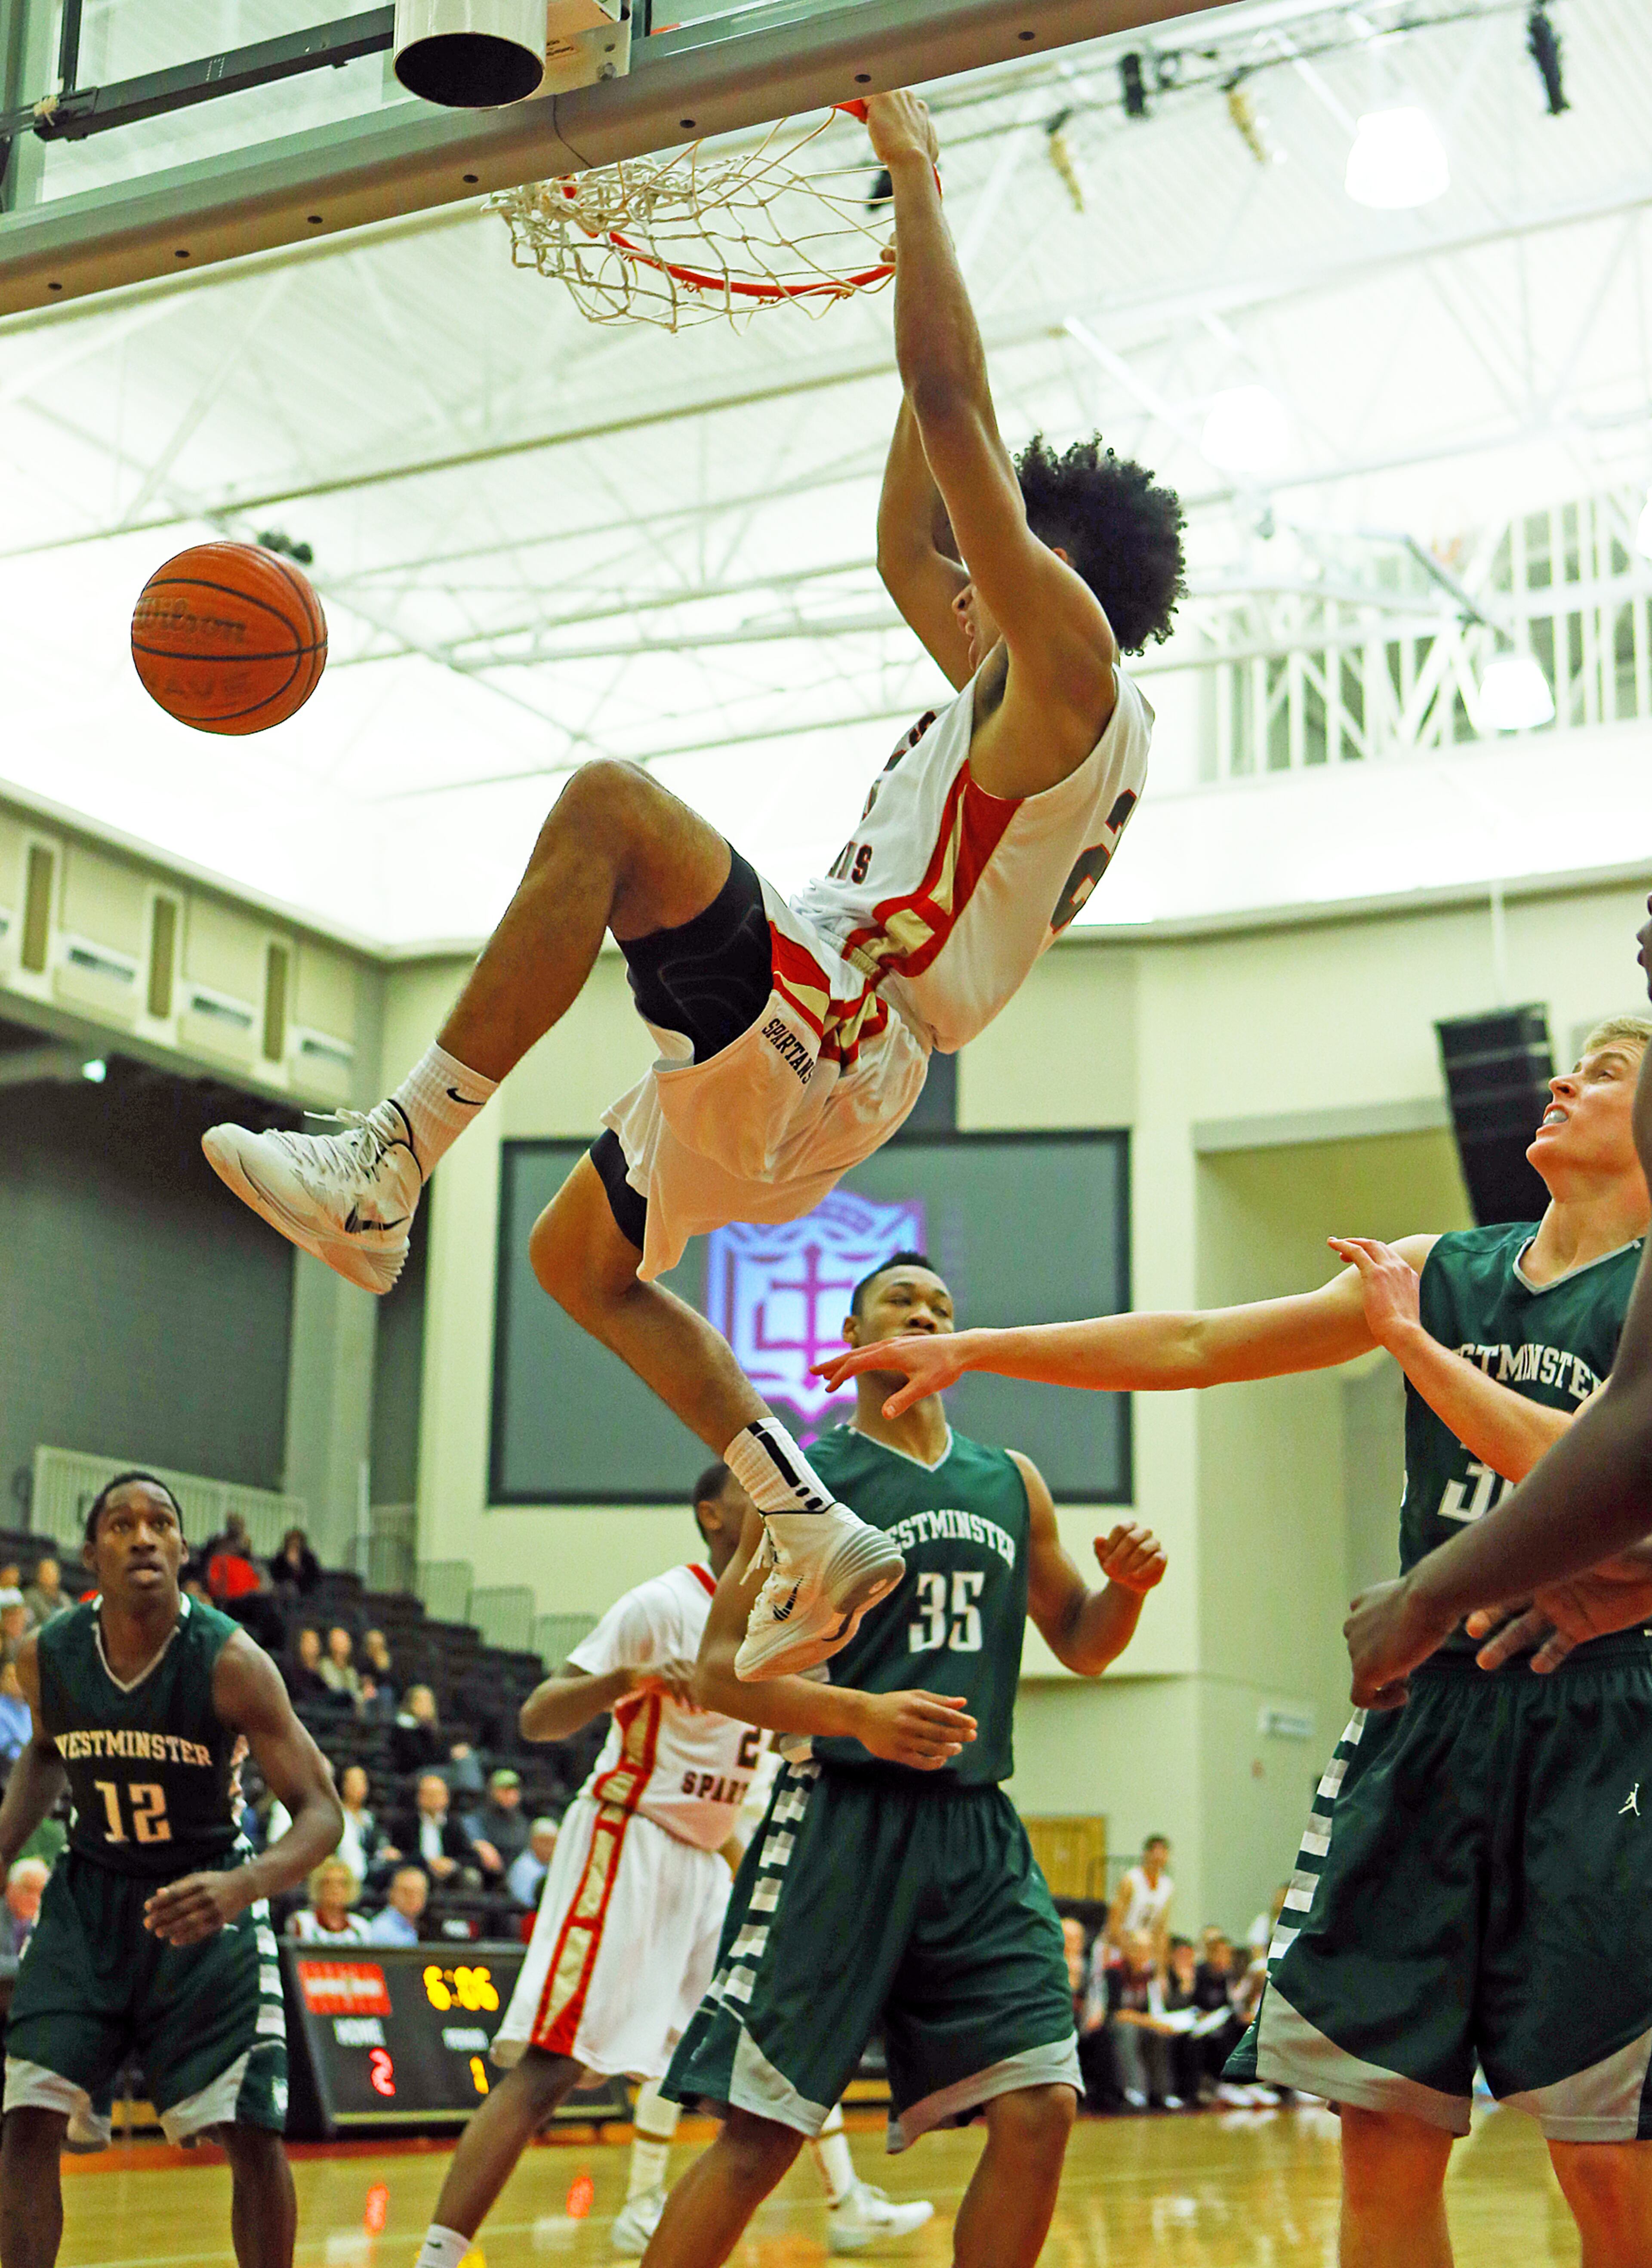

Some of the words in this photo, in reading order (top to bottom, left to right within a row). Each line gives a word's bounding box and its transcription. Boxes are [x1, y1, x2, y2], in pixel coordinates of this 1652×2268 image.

[761, 1018, 815, 1085] SPARTANS
[1452, 1343, 1603, 1401] STMINSTE
[1437, 1441, 1514, 1523] 3
[884, 1509, 1016, 1570] ESTMINSTER
[909, 1571, 985, 1653] 35
[93, 1779, 172, 1844] 12
[369, 2047, 396, 2096] 2
[469, 2056, 489, 2094] 1
